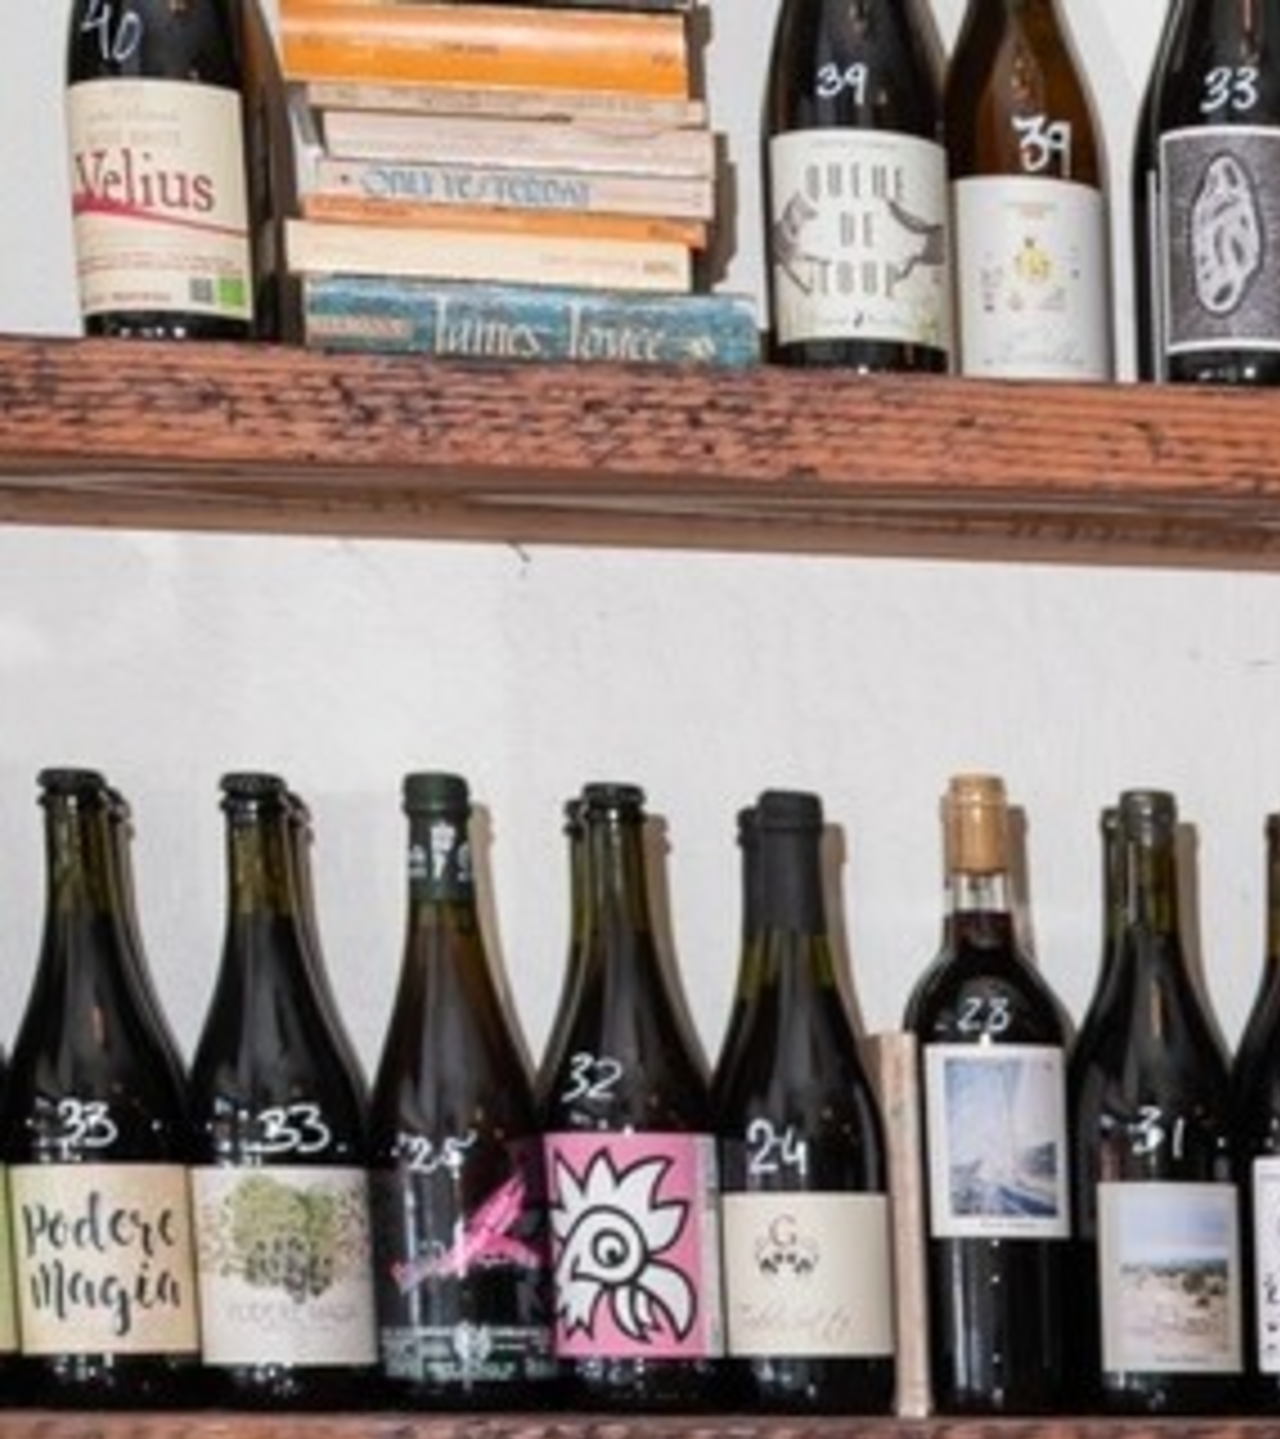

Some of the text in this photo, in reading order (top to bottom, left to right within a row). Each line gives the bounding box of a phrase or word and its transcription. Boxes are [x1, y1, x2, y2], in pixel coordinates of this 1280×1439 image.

[816, 62, 868, 104] 39
[1199, 66, 1260, 112] 33
[1012, 115, 1071, 178] 39
[76, 147, 215, 213] Velius
[562, 1052, 624, 1102] 32
[747, 1119, 807, 1176] 24
